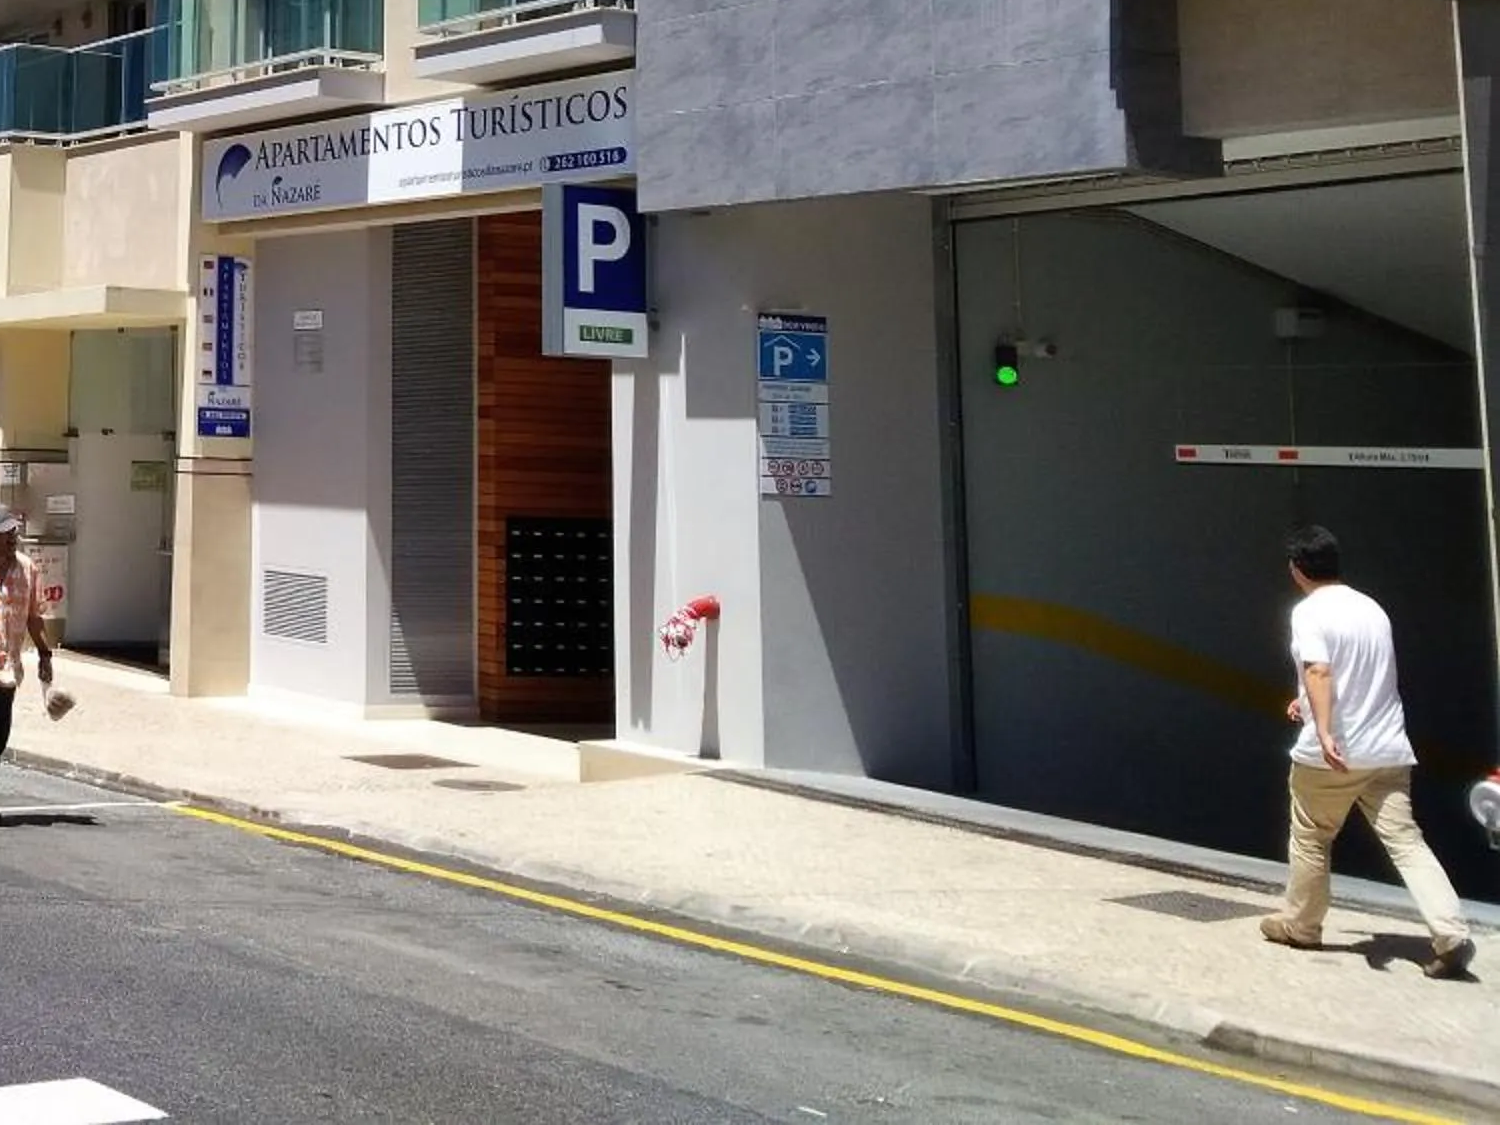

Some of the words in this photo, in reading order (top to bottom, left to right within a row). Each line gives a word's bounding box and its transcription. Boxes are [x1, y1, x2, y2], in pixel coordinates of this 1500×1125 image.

[254, 116, 442, 171] APARTAMENTOS
[451, 85, 628, 142] TURÍSTICOS
[577, 202, 631, 293] P
[583, 327, 625, 342] LIVRE
[773, 346, 794, 377] P
